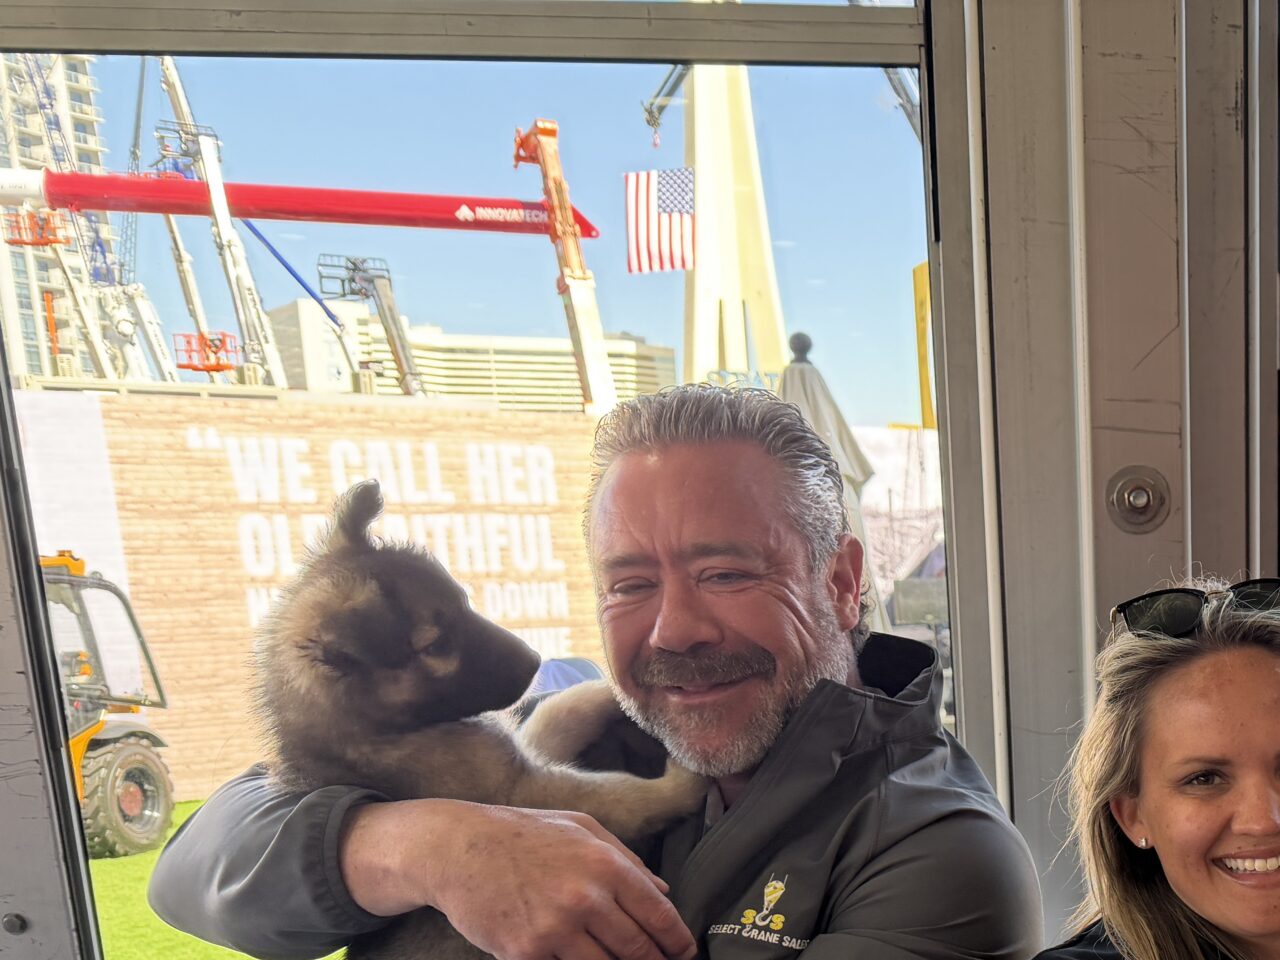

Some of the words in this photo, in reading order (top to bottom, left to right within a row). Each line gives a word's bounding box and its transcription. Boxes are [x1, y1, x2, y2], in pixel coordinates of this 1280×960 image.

[328, 439, 456, 503] CALL
[465, 443, 560, 504] HER
[484, 582, 569, 619] DOWN
[708, 923, 741, 935] SELECT
